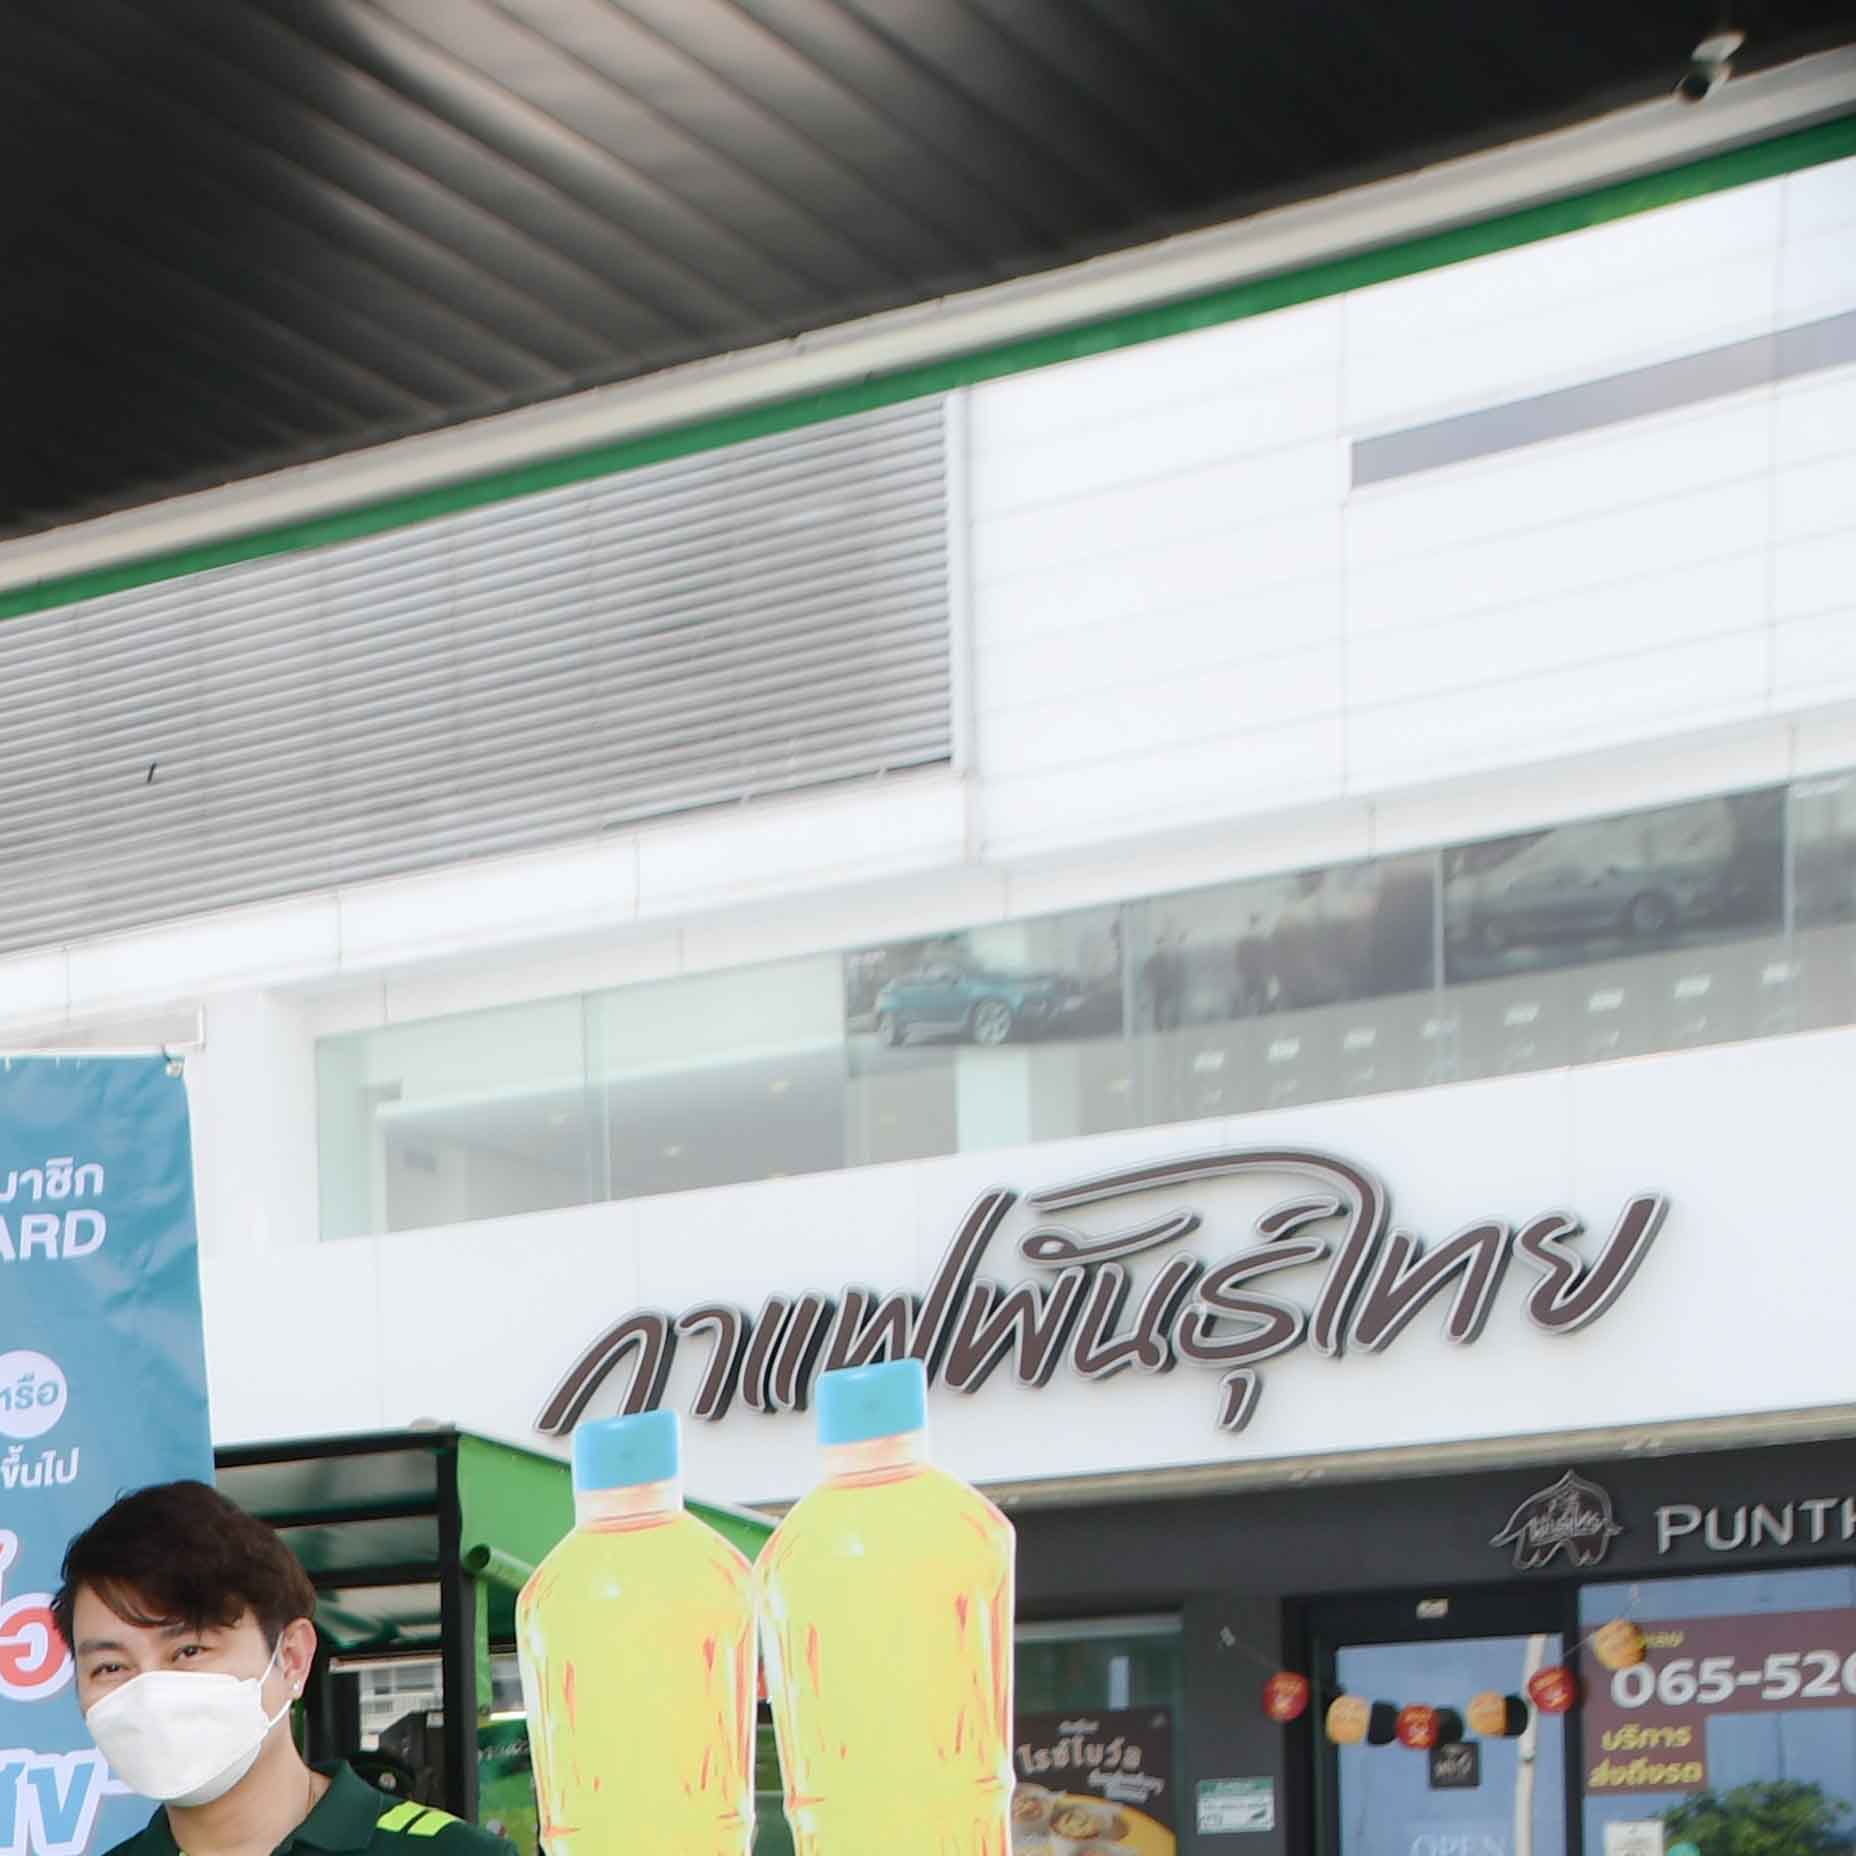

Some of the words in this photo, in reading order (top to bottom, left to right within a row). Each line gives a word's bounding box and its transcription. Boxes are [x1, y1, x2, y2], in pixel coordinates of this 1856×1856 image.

[536, 1148, 1670, 1434] กาแฟพันธุ์ไทย
